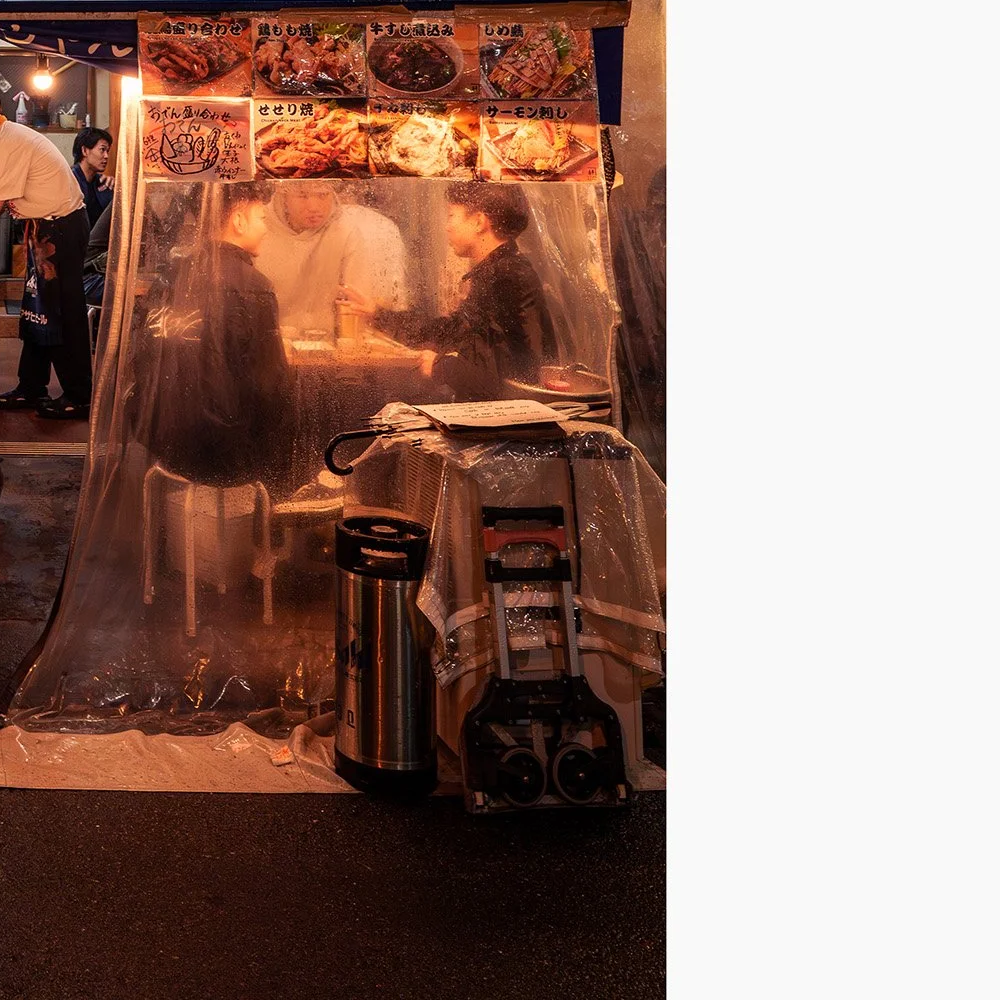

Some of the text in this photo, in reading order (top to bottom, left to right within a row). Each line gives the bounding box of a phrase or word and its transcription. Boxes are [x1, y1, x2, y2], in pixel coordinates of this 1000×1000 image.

[370, 22, 454, 37] 牛すじ煮込み
[148, 105, 231, 122] おでん盛り合わせ
[259, 103, 314, 117] せせり焼
[486, 105, 568, 119] サーモン刺し
